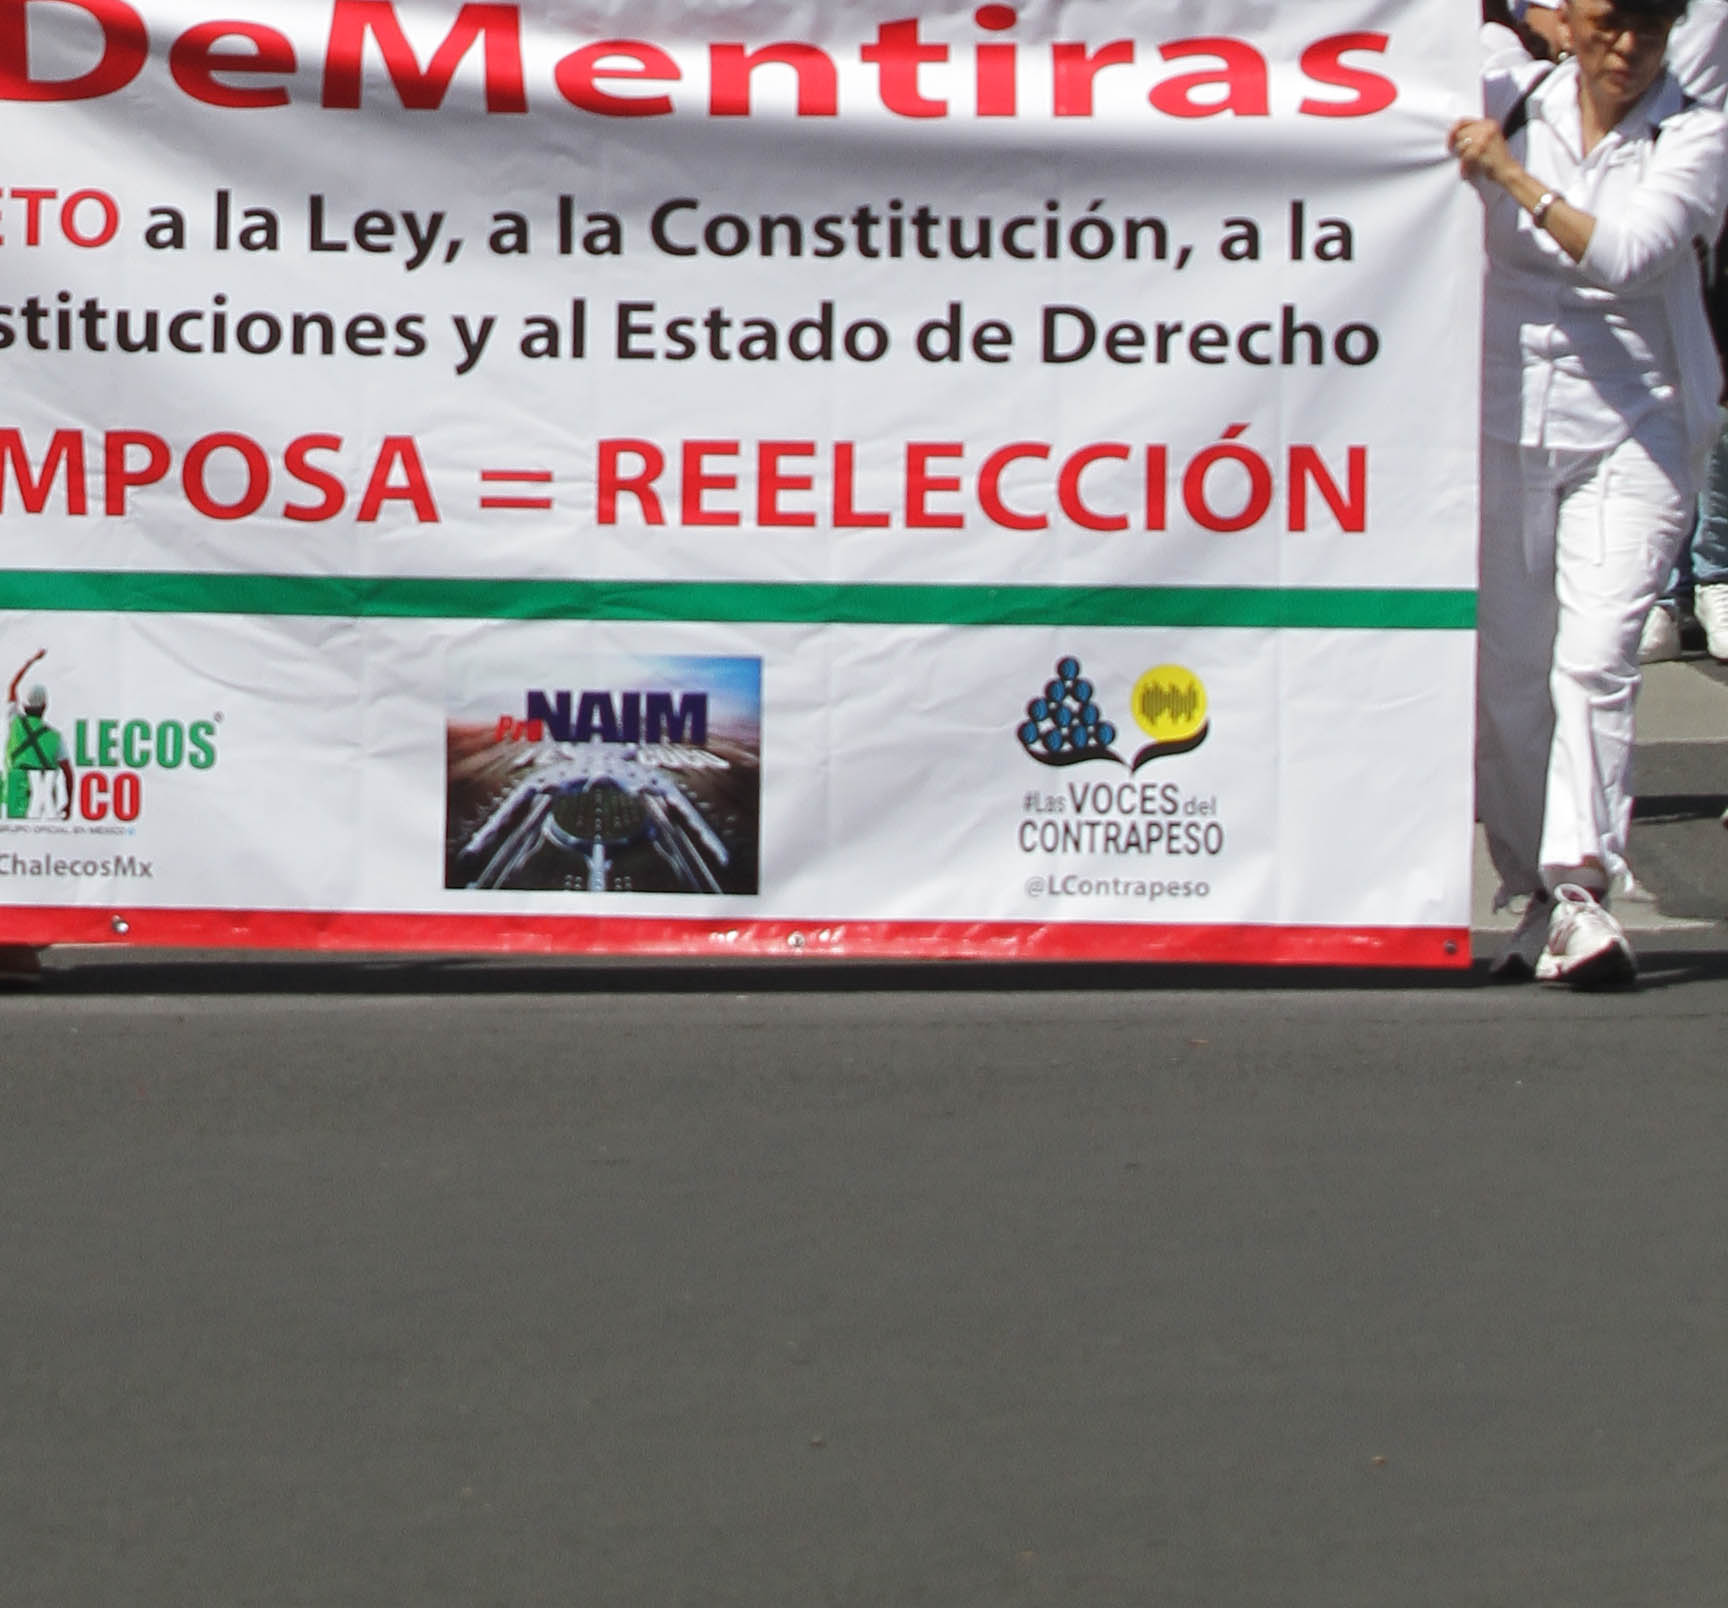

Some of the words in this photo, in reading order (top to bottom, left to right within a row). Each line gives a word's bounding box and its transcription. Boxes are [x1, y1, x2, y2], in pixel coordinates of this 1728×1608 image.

[145, 208, 184, 250] a
[216, 190, 278, 252] la
[309, 194, 462, 271] Ley,
[489, 212, 528, 255] a
[559, 194, 622, 256] la
[650, 198, 1193, 272] Constitución,
[1221, 219, 1260, 261] a
[1291, 201, 1354, 262] la
[453, 316, 495, 375] y
[520, 299, 585, 359] al
[616, 301, 889, 362] Estado
[916, 303, 1013, 363] de
[1042, 304, 1380, 366] Derecho
[595, 423, 1368, 534] REELECCIÓN
[527, 690, 707, 745] NAIM
[1068, 782, 1180, 816] VOCES
[1183, 795, 1217, 816] del
[1018, 819, 1224, 856] CONTRAPESO
[1024, 874, 1210, 902] @LContrapeso
